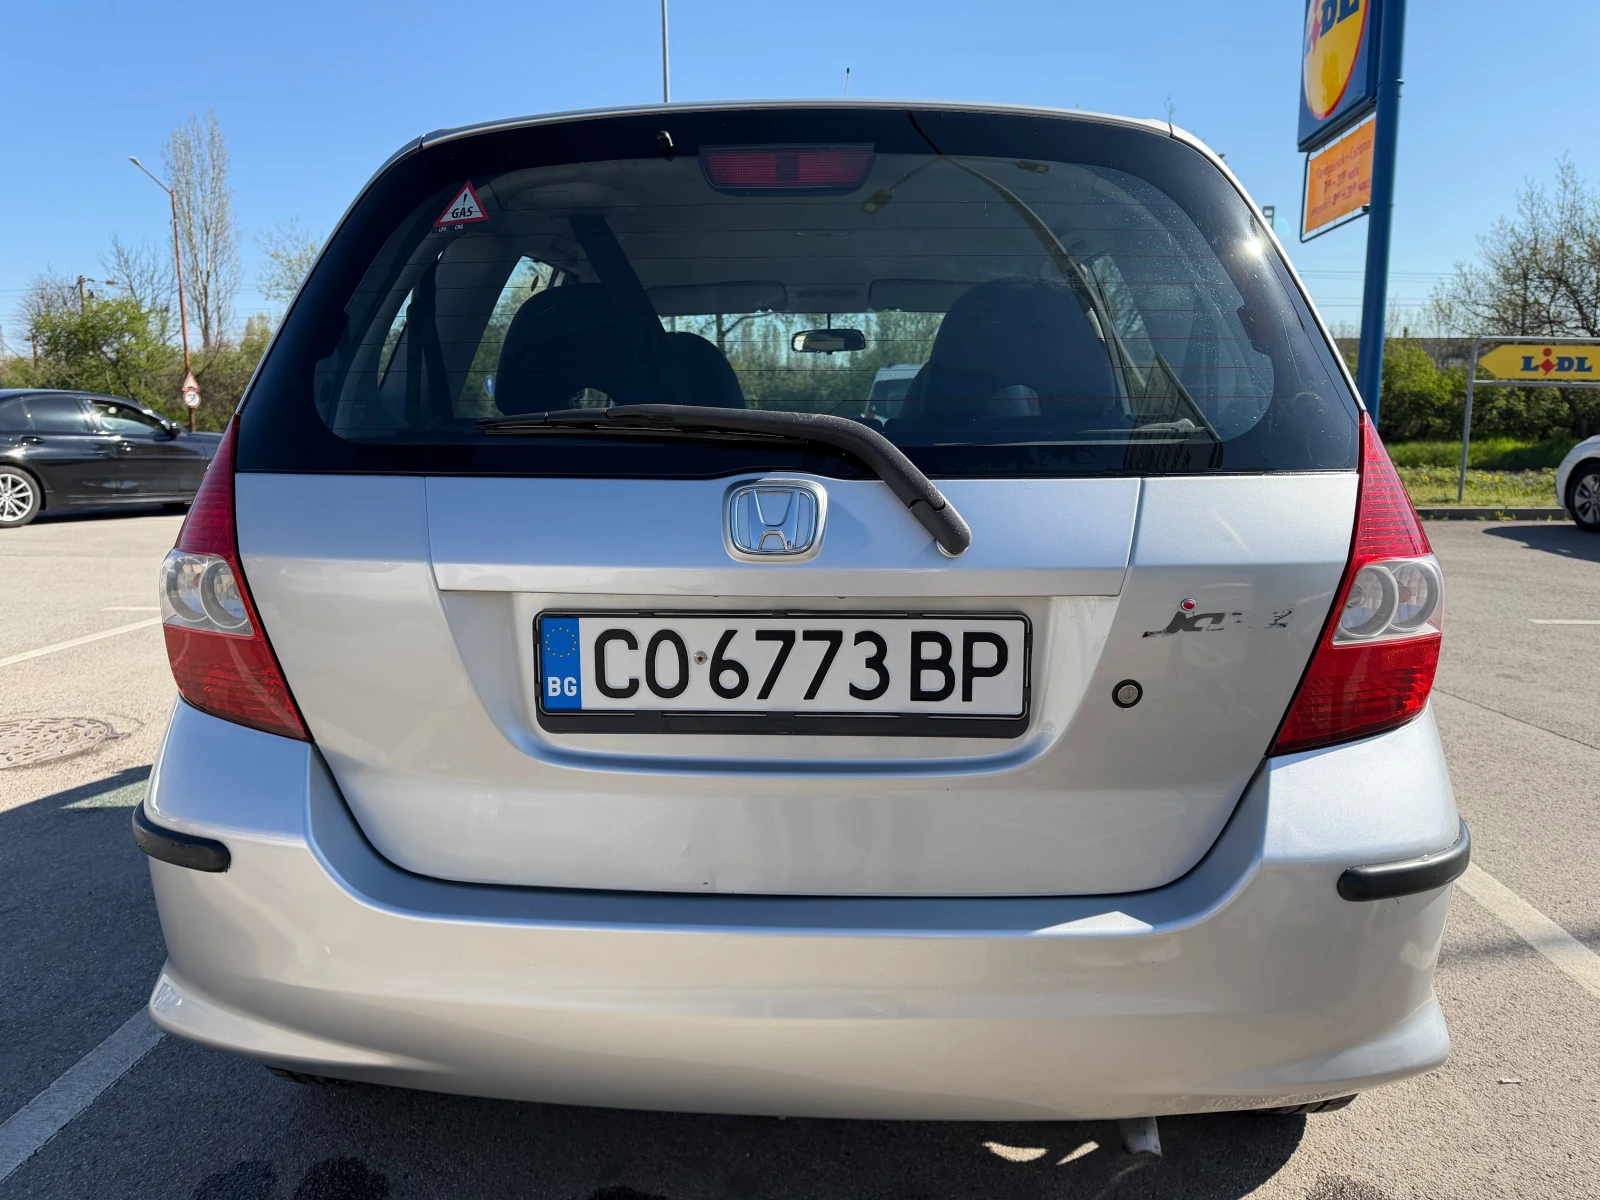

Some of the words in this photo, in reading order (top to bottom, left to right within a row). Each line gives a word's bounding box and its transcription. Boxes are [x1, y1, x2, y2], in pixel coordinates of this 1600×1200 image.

[451, 206, 474, 219] GAS
[594, 628, 689, 699] CO
[709, 629, 890, 701] 6773
[910, 630, 1008, 702] BP
[547, 676, 577, 697] BG
